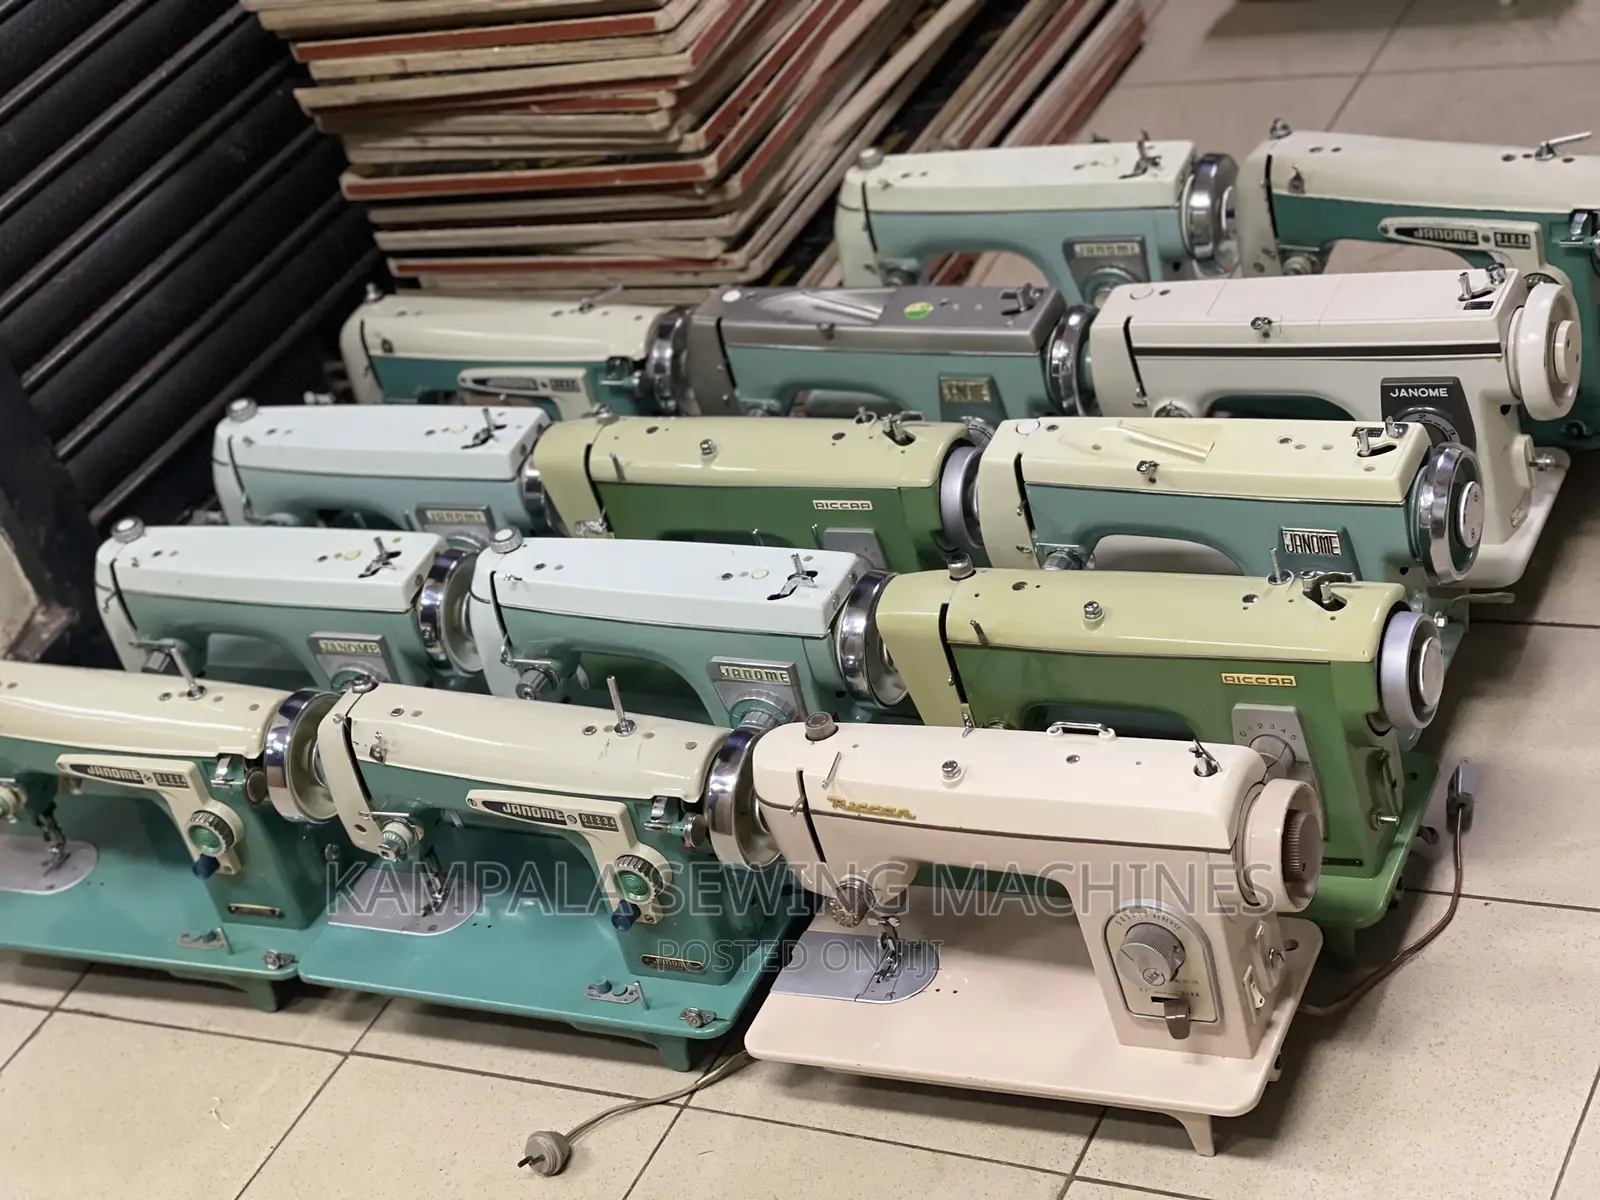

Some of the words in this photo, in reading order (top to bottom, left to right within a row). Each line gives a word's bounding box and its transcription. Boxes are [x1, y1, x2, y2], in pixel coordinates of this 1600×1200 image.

[1414, 228, 1477, 244] JANOME
[1390, 388, 1448, 397] JANOME
[1285, 533, 1341, 556] JANOME
[721, 667, 791, 682] JANOME
[1224, 676, 1293, 685] RICCAR
[87, 766, 142, 781] JANOME
[502, 803, 565, 821] JANOME
[581, 815, 616, 826] 01234
